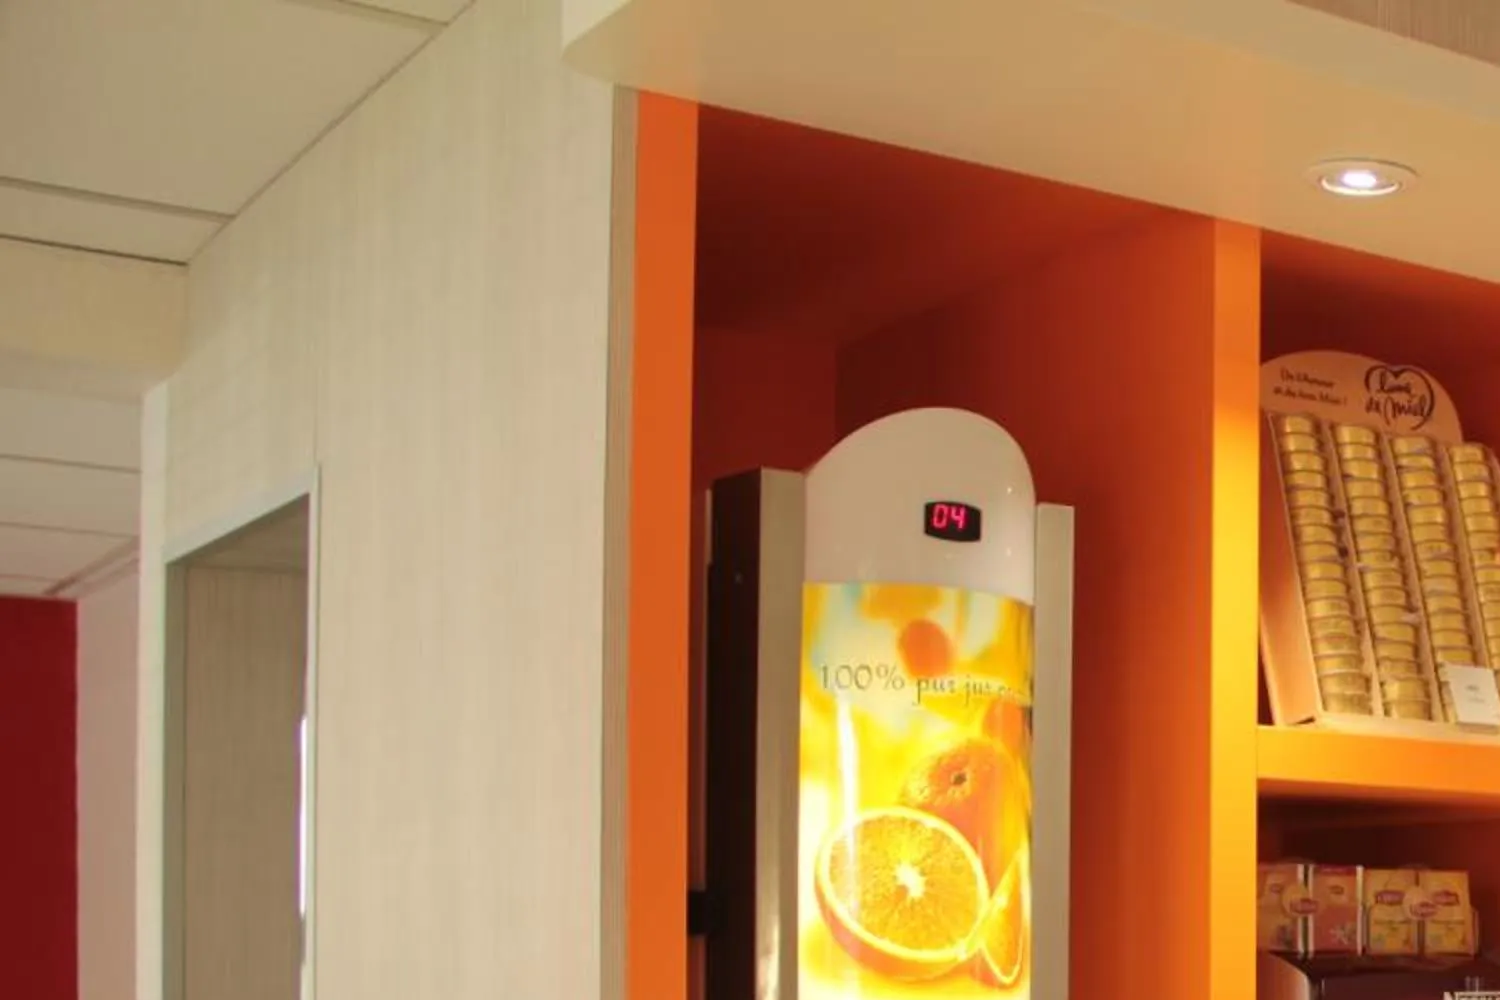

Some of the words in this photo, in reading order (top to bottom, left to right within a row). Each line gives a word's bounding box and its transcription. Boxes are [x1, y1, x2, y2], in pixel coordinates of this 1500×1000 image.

[932, 503, 966, 530] 04
[821, 663, 905, 691] 100%
[911, 676, 956, 706] pur
